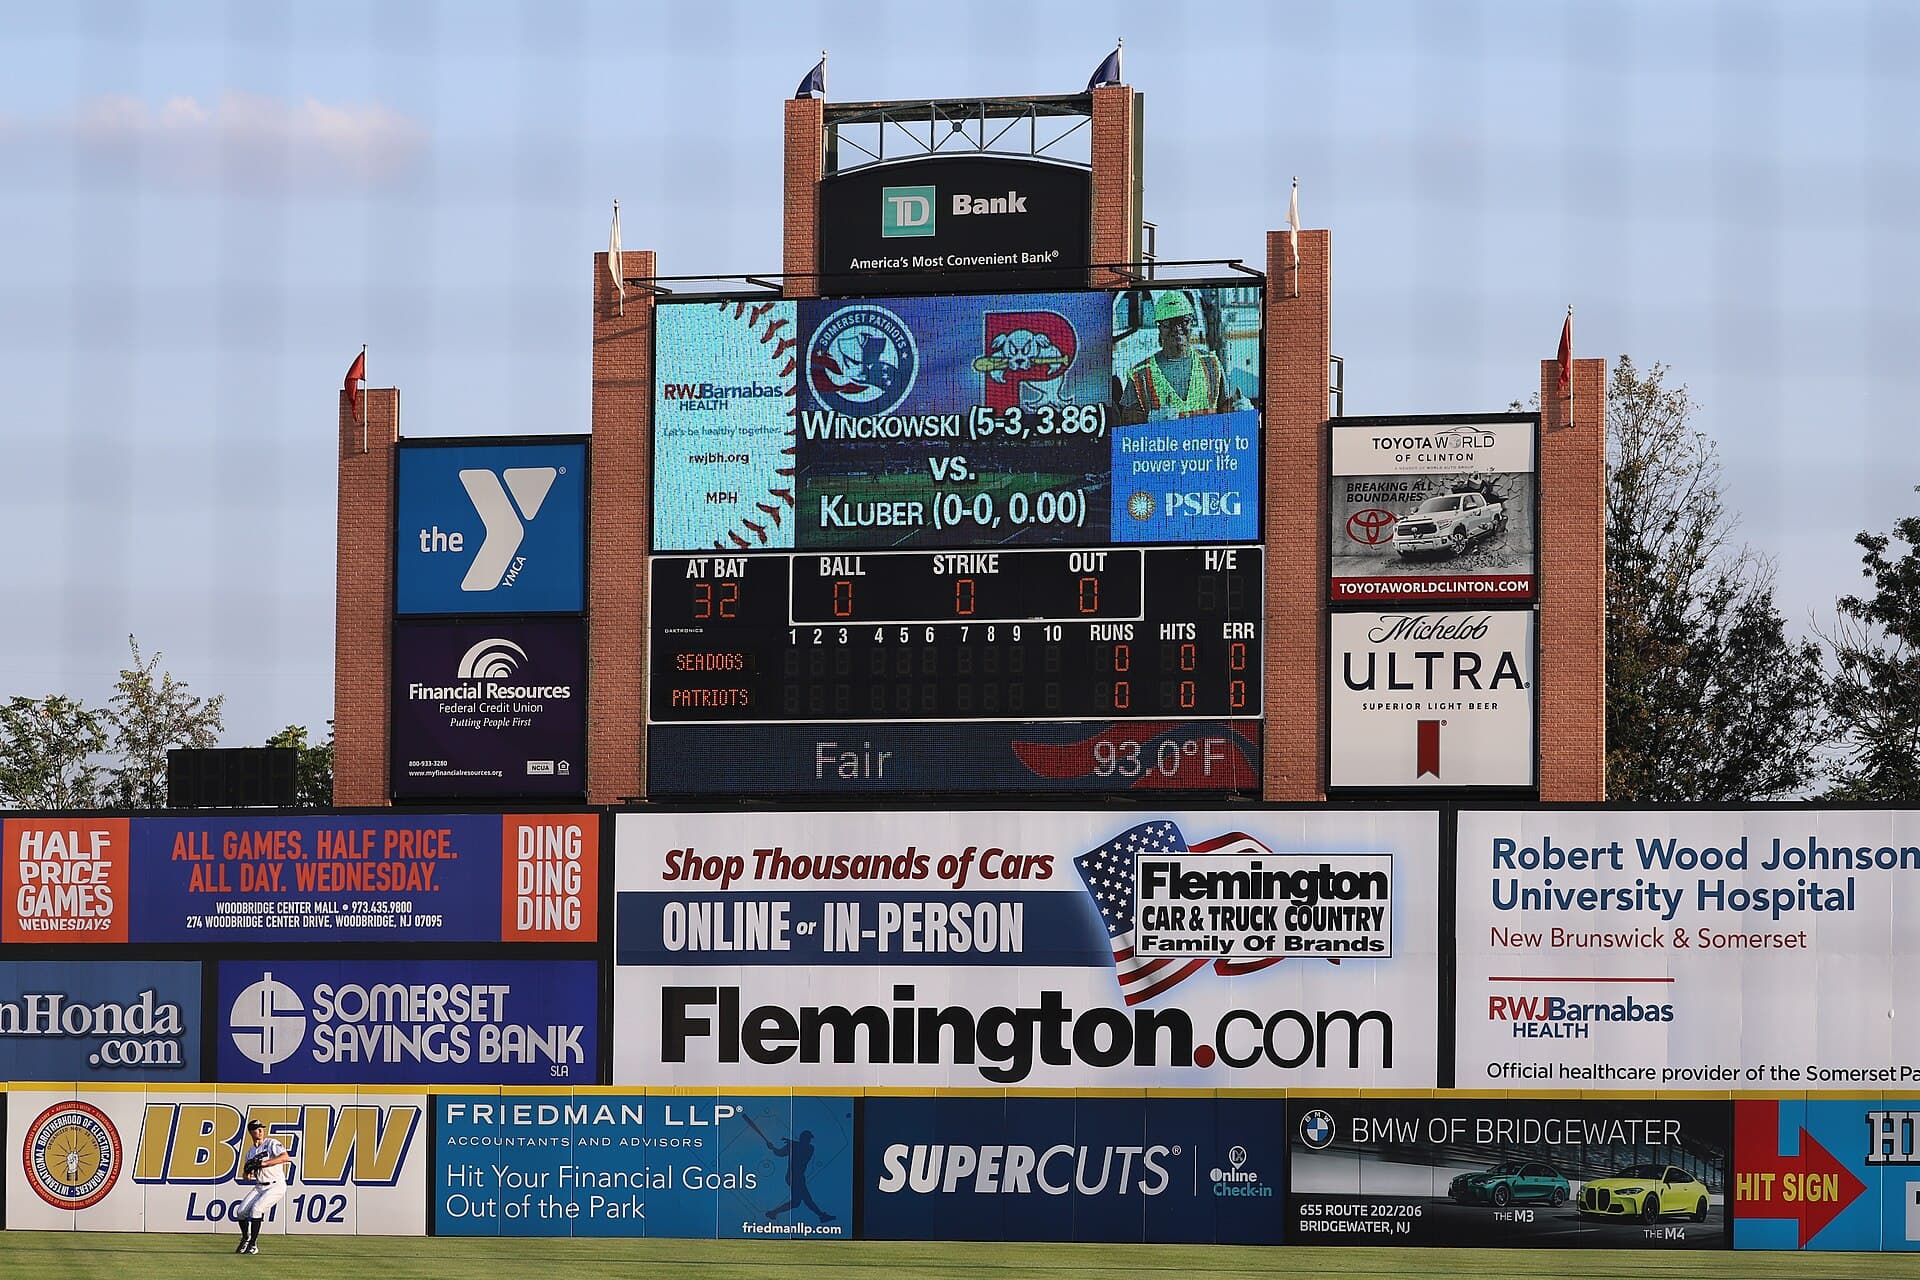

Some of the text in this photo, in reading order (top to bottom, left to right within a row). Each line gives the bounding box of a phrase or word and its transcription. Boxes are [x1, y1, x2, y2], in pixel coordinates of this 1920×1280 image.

[953, 191, 1027, 215] Bank
[850, 256, 908, 270] America's
[912, 254, 943, 268] Most
[947, 252, 1018, 267] Convenient
[820, 313, 907, 348] SOMERSET PATRIOTS
[664, 382, 783, 400] RWJBarnabas
[679, 400, 728, 411] HEALTH
[969, 405, 1030, 440] (5-3,
[1036, 403, 1106, 438] 3.86)
[1122, 436, 1249, 455] Reliable energy to
[1372, 437, 1432, 450] TOYOTA
[689, 453, 749, 465] rwjbh.org
[1132, 455, 1238, 475] power your life
[1346, 481, 1434, 493] BREAKING ALL
[1346, 492, 1423, 503] BOUNDARIES
[706, 492, 737, 504] MPH
[933, 491, 1001, 530] (0-0,
[1008, 489, 1086, 527] 0.00)
[419, 526, 464, 553] the
[686, 558, 748, 579] AT BAT
[820, 557, 866, 576] BALL
[933, 554, 999, 575] STRIKE
[1069, 552, 1107, 573] OUT
[1340, 581, 1529, 596] TOYOTAWORLDCLINTON.COM
[1090, 624, 1134, 641] RUNS
[1160, 623, 1196, 640] HITS
[1223, 623, 1255, 640] ERR
[1368, 615, 1493, 644] Michelob
[676, 653, 744, 671] SEADOGS
[409, 682, 570, 700] Financial Resources
[672, 689, 749, 707] PATRIOTS
[439, 702, 543, 713] Federal Credit Union
[1362, 702, 1499, 710] SUPERIOR LIGHT BEER
[450, 717, 531, 729] Putting People First
[815, 739, 1225, 779] Fair 93.0°F
[409, 769, 502, 778] www.myfinancialresources.org
[19, 831, 111, 861] HALF
[171, 829, 458, 861] ALL GAMES. HALF PRICE.
[517, 825, 582, 860] DING
[1492, 837, 1920, 871] Robert Wood Johnson
[19, 861, 112, 885] PRICE
[188, 862, 440, 893] ALL DAY. WEDNESDAY.
[517, 860, 582, 895] DING
[662, 846, 1055, 890] Shop Thousands of Cars
[1141, 861, 1388, 907] Flemington
[16, 884, 114, 918] GAMES
[216, 901, 412, 915] WOODBRIDGE CENTER MALL 973.435.9800
[1492, 878, 1856, 920] University Hospital
[186, 914, 443, 929] 274 WOODBRIDGE CENTER DRIVE, WOODBRIDGE, NJ 07095
[517, 896, 581, 931] DING
[1142, 906, 1385, 932] CAR & TRUCK COUNTRY
[18, 918, 112, 931] WEDNESDAYS
[662, 901, 1024, 953] ONLINE or IN-PERSON
[1141, 935, 1385, 954] Family Of Brands
[1490, 927, 1807, 949] New Brunswick & Somerset
[312, 983, 510, 1023] SOMERSET
[1488, 996, 1674, 1023] RWJBarnabas
[660, 985, 1394, 1082] Flemington.com
[1513, 1023, 1589, 1038] HEALTH
[89, 1039, 182, 1064] .com
[312, 1023, 585, 1064] SAVINGS BANK
[1487, 1062, 1897, 1083] Official healthcare provider of the Somerset
[447, 1104, 643, 1126] FRIEDMAN
[447, 1136, 703, 1148] ACCOUNTANTS AND ADVISORS
[1352, 1118, 1681, 1145] BMW OF BRIDGEWATER
[447, 1165, 757, 1190] Hit Your Financial Goals
[1209, 1168, 1257, 1183] Online
[1212, 1183, 1273, 1197] Check-in
[1736, 1173, 1838, 1202] HIT SIGN
[292, 1194, 347, 1223] 102
[447, 1194, 645, 1219] Out of the Park
[1299, 1205, 1423, 1219] 655 ROUTE 202/206
[742, 1221, 842, 1236] friedmanllp.com
[1299, 1220, 1410, 1235] BRIDGEWATER, NJ
